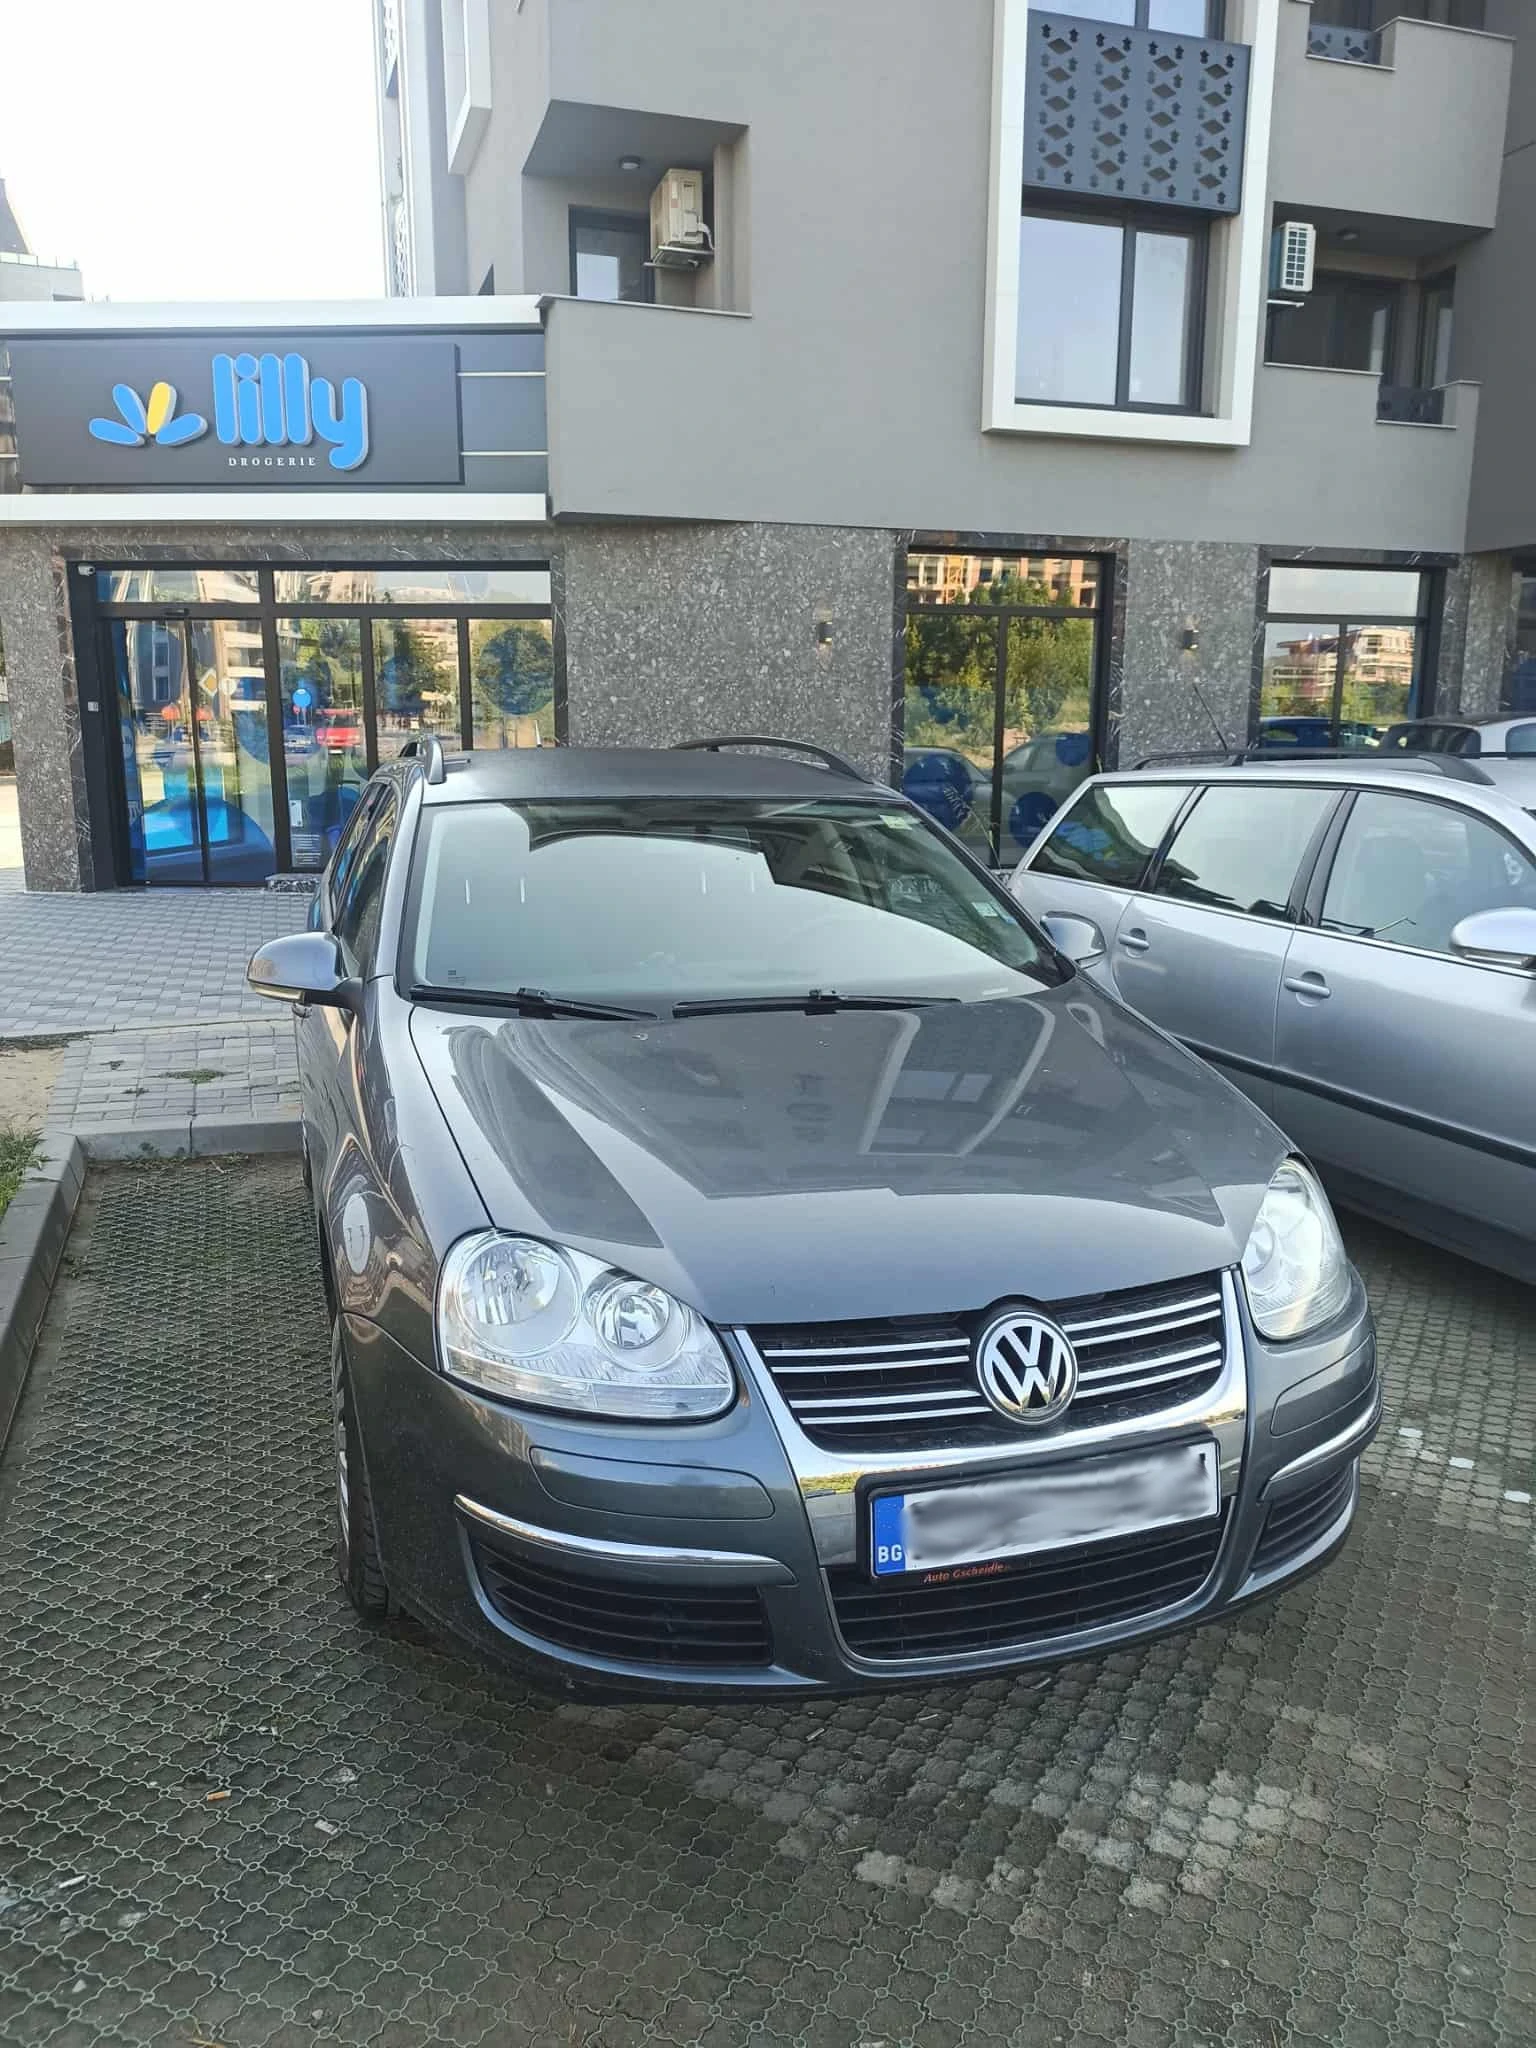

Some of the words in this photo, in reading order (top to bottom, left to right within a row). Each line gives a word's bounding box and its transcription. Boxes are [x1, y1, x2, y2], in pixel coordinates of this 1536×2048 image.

[212, 352, 369, 470] lilly
[228, 457, 317, 467] DROGERIE
[981, 1316, 1074, 1418] VW
[878, 1544, 903, 1563] BG
[923, 1572, 950, 1584] Auto
